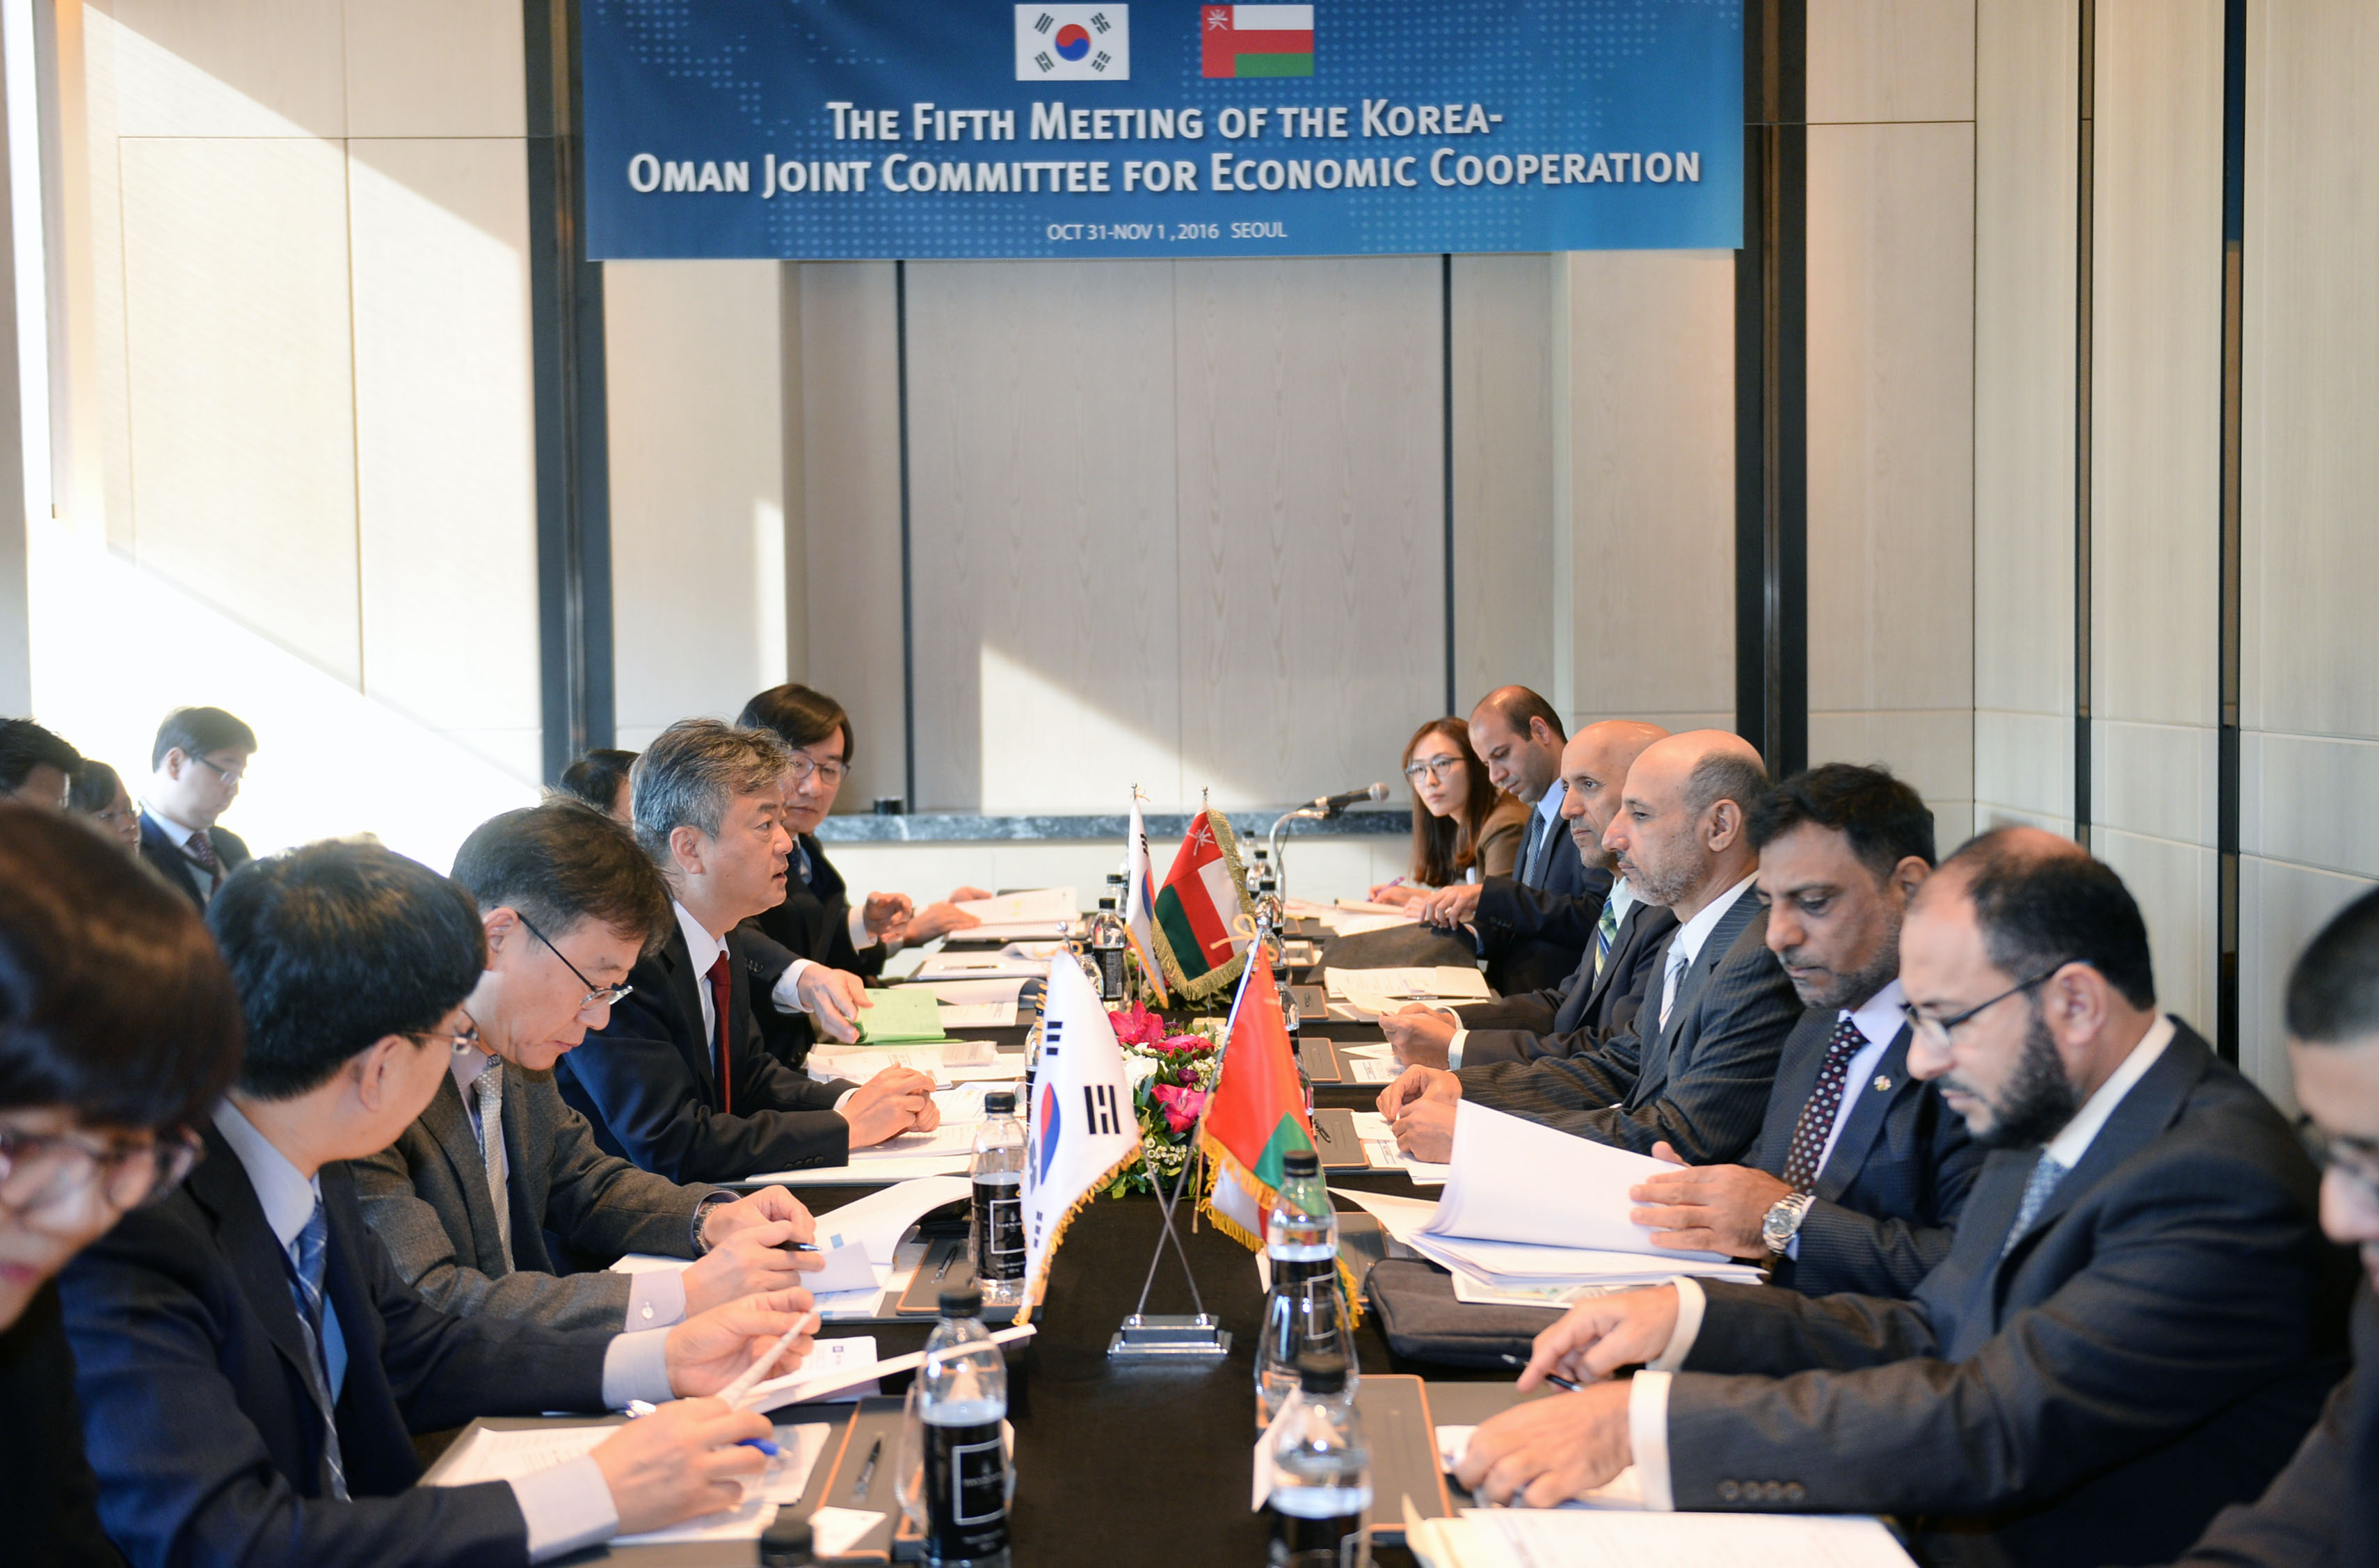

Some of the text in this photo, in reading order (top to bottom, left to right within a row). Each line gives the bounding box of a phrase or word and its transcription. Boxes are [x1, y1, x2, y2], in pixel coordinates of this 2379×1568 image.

[1048, 224, 1083, 240] OCT
[1088, 224, 1153, 240] 31-NOV
[1231, 222, 1287, 239] SEOUL
